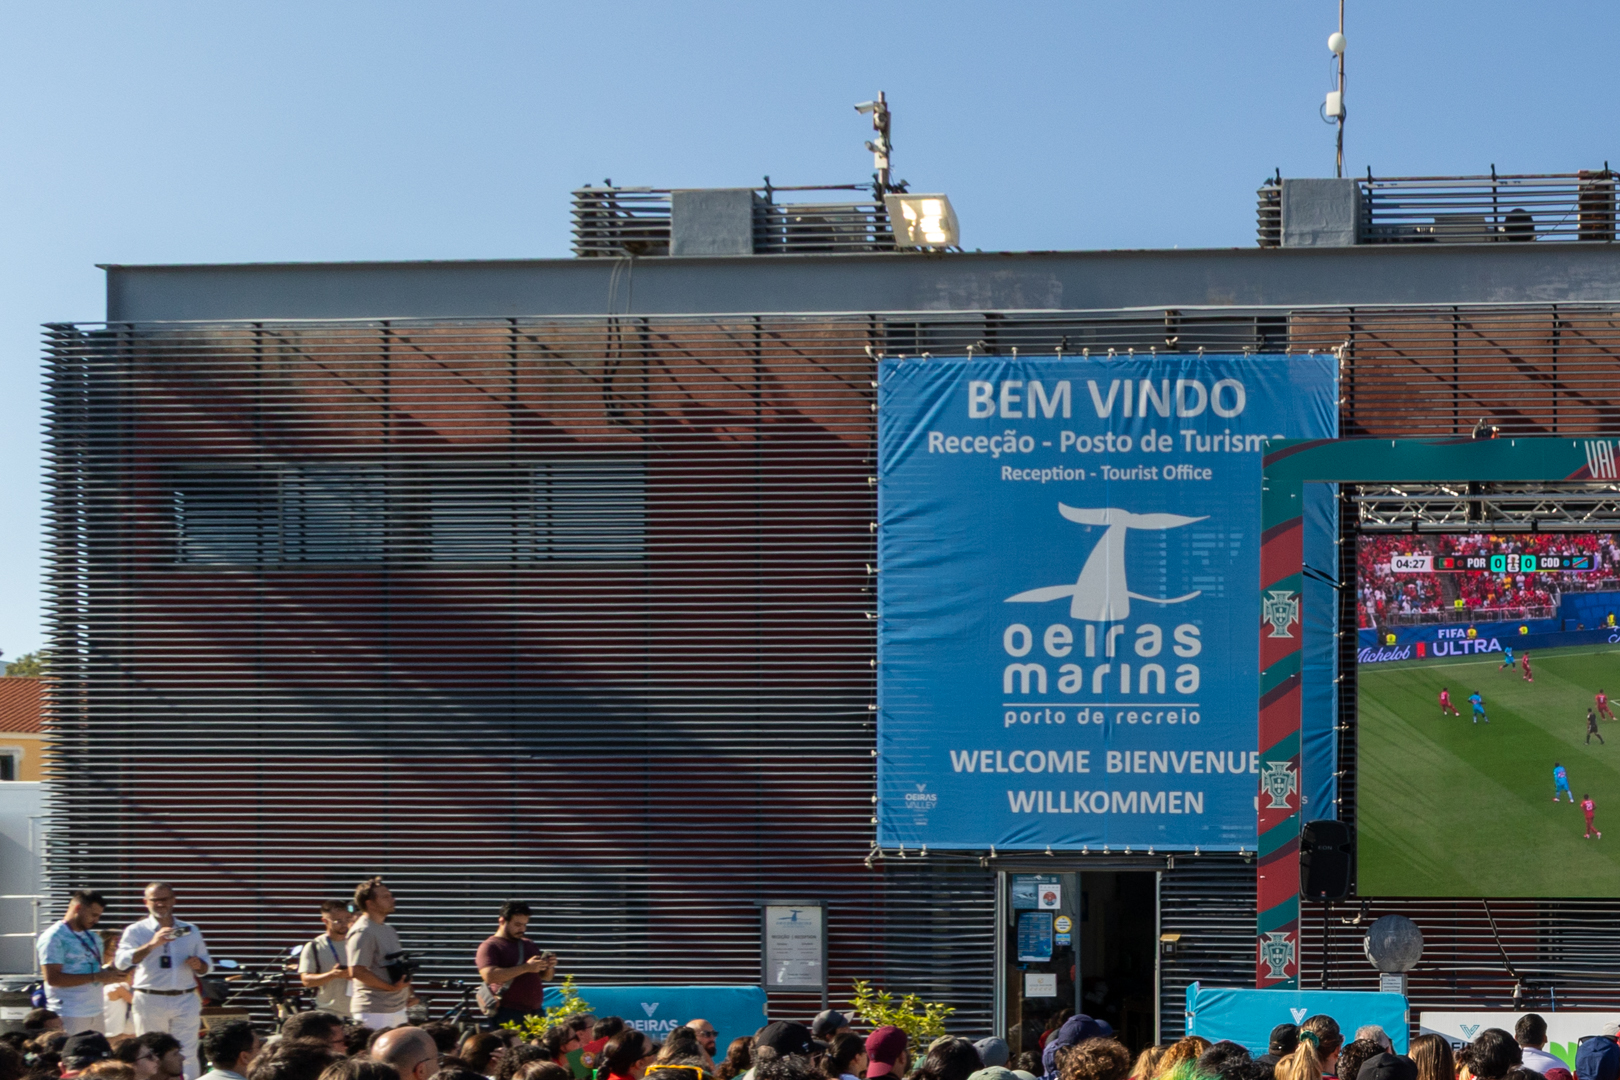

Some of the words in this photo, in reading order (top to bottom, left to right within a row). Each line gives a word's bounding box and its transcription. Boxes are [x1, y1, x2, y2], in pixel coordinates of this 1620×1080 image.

[967, 380, 1072, 419] BEM
[1087, 378, 1247, 418] VINDO
[928, 430, 1035, 457] Receção
[1060, 431, 1133, 454] Posto
[1140, 430, 1171, 454] de
[1180, 428, 1286, 453] Turism
[1584, 440, 1617, 479] VAI
[1001, 465, 1085, 482] Reception
[1101, 465, 1158, 481] Tourist
[1163, 464, 1213, 481] Office
[1395, 559, 1426, 569] 04:27
[1467, 557, 1486, 569] POR
[1493, 557, 1502, 569] 0
[1524, 557, 1533, 569] 0
[1541, 557, 1560, 568] COD
[1003, 623, 1202, 657] oeiras
[1437, 628, 1466, 639] FIFA
[1432, 637, 1502, 657] ULTRA
[1003, 663, 1201, 694] marina
[1004, 708, 1066, 728] porto
[1077, 708, 1104, 725] de
[1116, 708, 1201, 725] recreio
[950, 749, 1090, 774] WELCOME
[905, 793, 937, 801] OEIRAS
[1007, 790, 1204, 815] WILLKOMMEN
